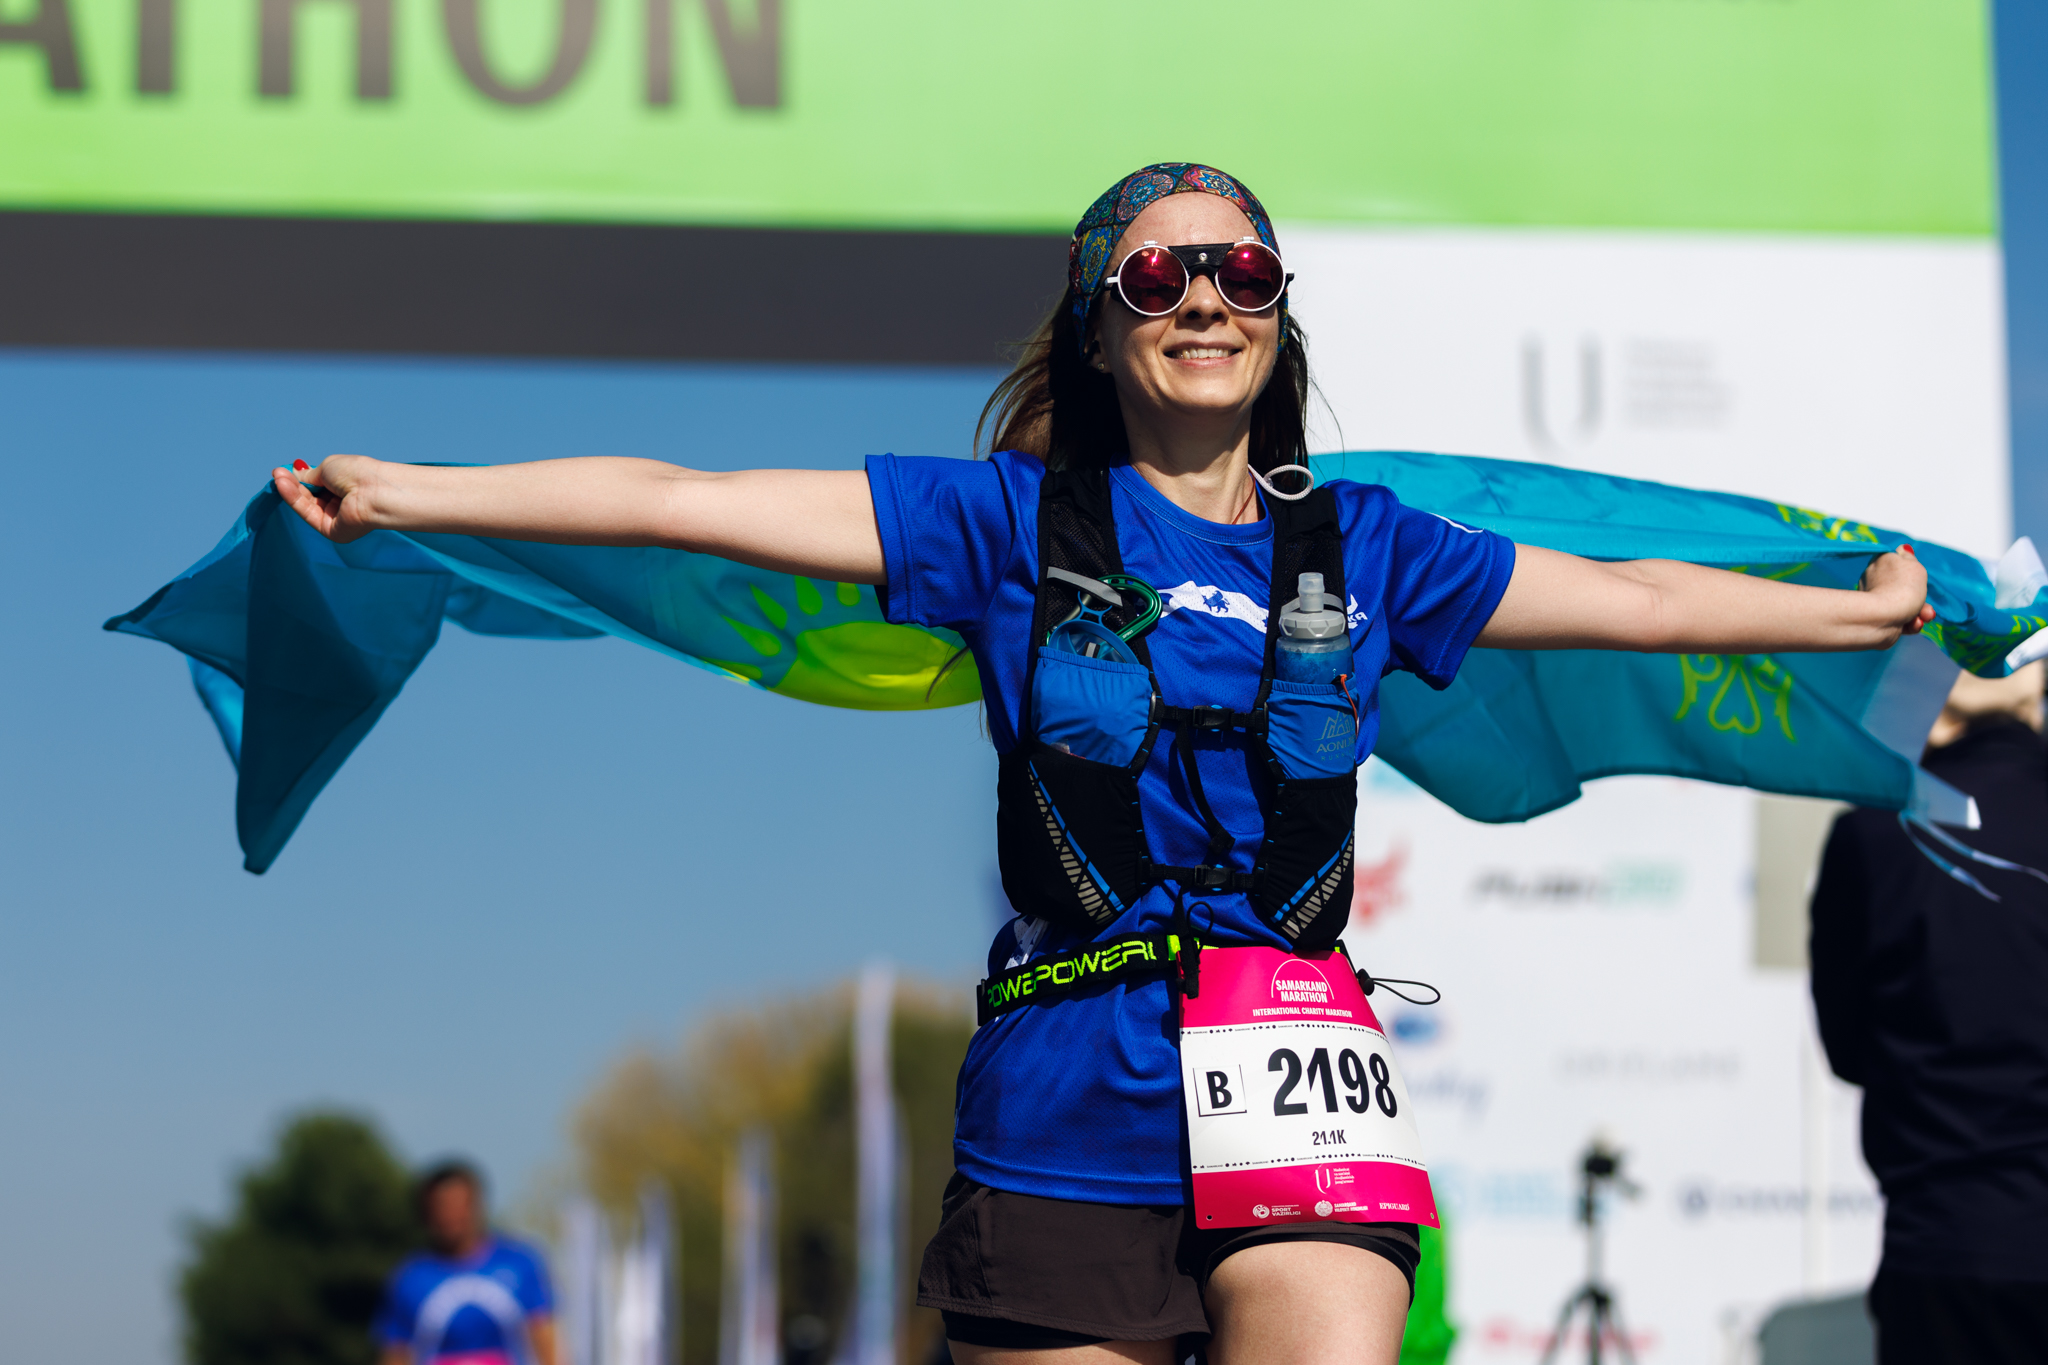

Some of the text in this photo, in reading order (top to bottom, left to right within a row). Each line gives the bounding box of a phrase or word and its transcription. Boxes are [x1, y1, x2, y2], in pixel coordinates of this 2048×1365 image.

[1275, 980, 1328, 992] SAMARKAND
[1280, 991, 1328, 1003] MARATHON
[1253, 1007, 1353, 1018] INTERNATIONAL CHARITY MARATHON
[1205, 1070, 1233, 1109] B
[1268, 1047, 1398, 1119] 2198
[1312, 1129, 1347, 1146] 21.1K
